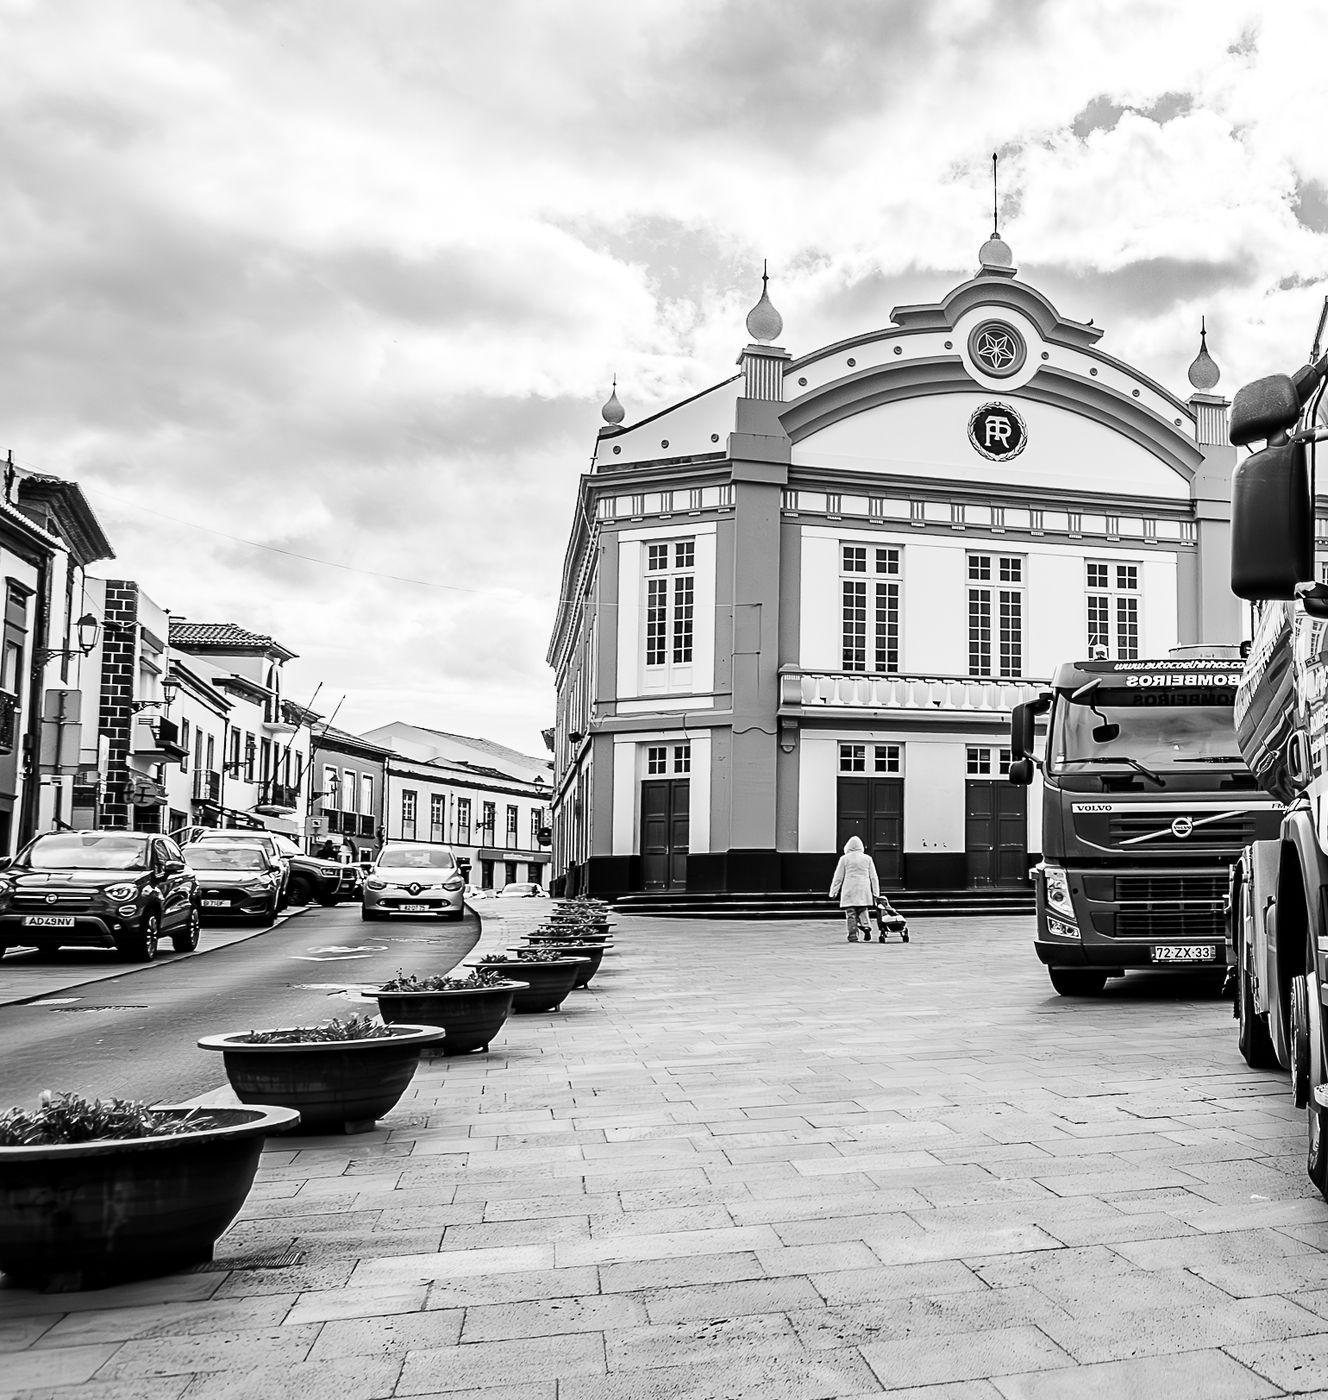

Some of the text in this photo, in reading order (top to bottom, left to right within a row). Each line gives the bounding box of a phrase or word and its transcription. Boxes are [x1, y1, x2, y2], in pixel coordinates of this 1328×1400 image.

[1114, 660, 1246, 671] www.autocoelhinhos.co
[1077, 804, 1112, 812] VOLVO
[29, 917, 72, 926] AD49NV
